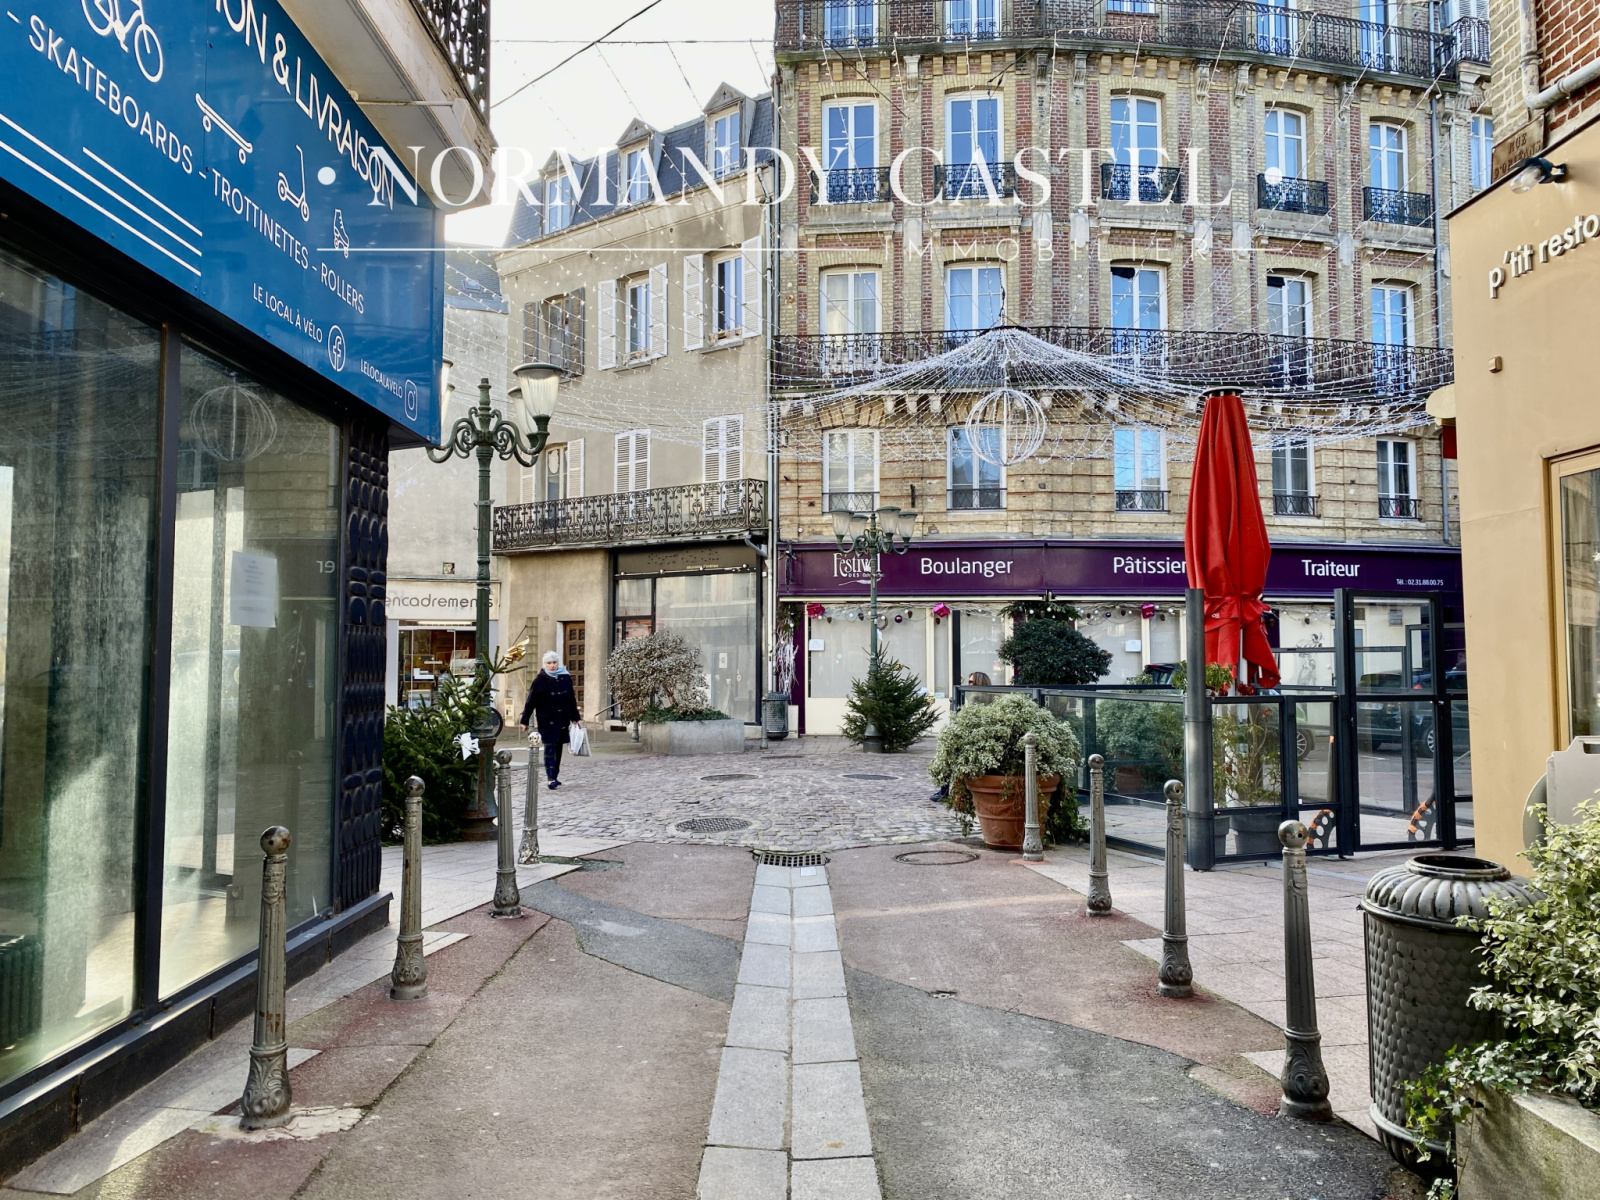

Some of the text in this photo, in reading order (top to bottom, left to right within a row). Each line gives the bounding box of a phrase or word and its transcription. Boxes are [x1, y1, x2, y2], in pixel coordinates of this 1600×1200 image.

[215, 0, 393, 210] ON & LIVRAISON
[29, 15, 193, 174] SKATEBOARDS
[212, 168, 309, 270] TROTTINETTES
[321, 262, 364, 314] ROLLERS
[1488, 214, 1600, 299] p'tit resto
[253, 282, 263, 304] LE
[265, 291, 294, 325] LOCAL
[295, 308, 302, 328] À
[303, 318, 323, 343] VÉLO
[360, 358, 403, 399] LELOCALAVELO
[832, 552, 881, 577] Festivl
[921, 556, 1361, 578] Boulanger Pâtissier Traiteur
[384, 593, 494, 608] encadremens
